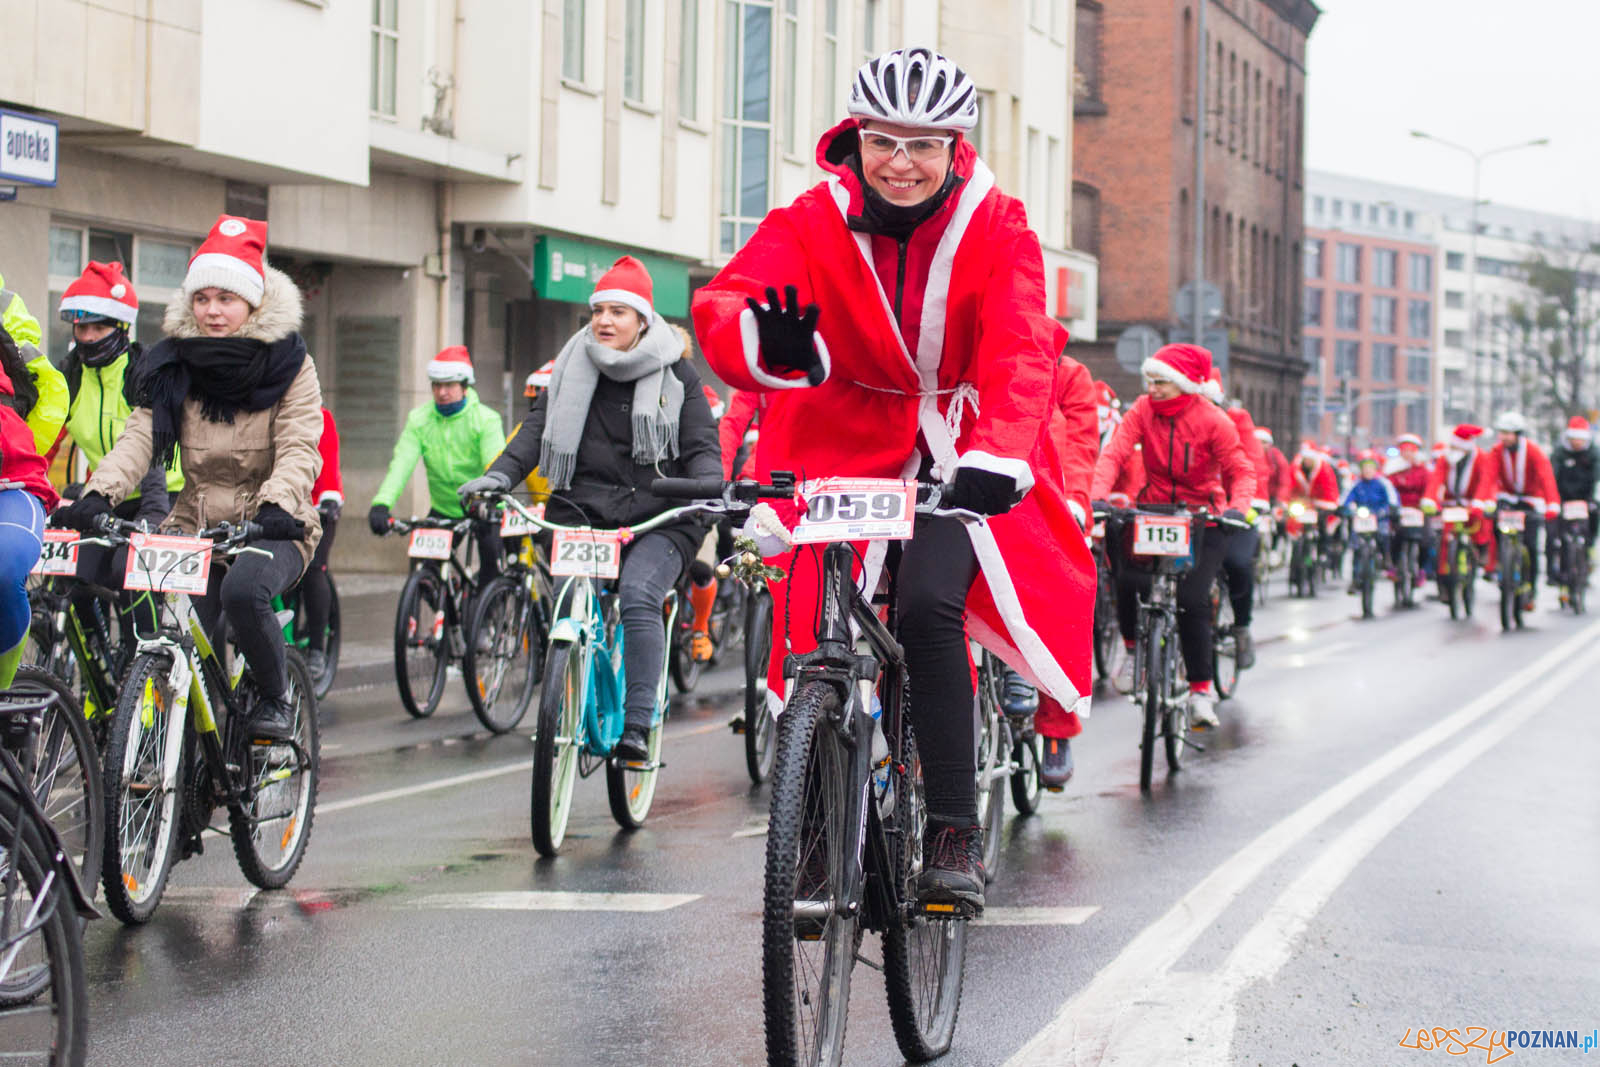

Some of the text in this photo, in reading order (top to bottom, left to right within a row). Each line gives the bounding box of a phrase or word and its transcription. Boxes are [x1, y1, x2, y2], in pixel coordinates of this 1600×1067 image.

[6, 130, 50, 162] apteka
[806, 493, 902, 522] 059
[1144, 527, 1179, 543] 115
[41, 542, 71, 560] 34
[136, 548, 200, 575] 026
[559, 542, 612, 563] 233
